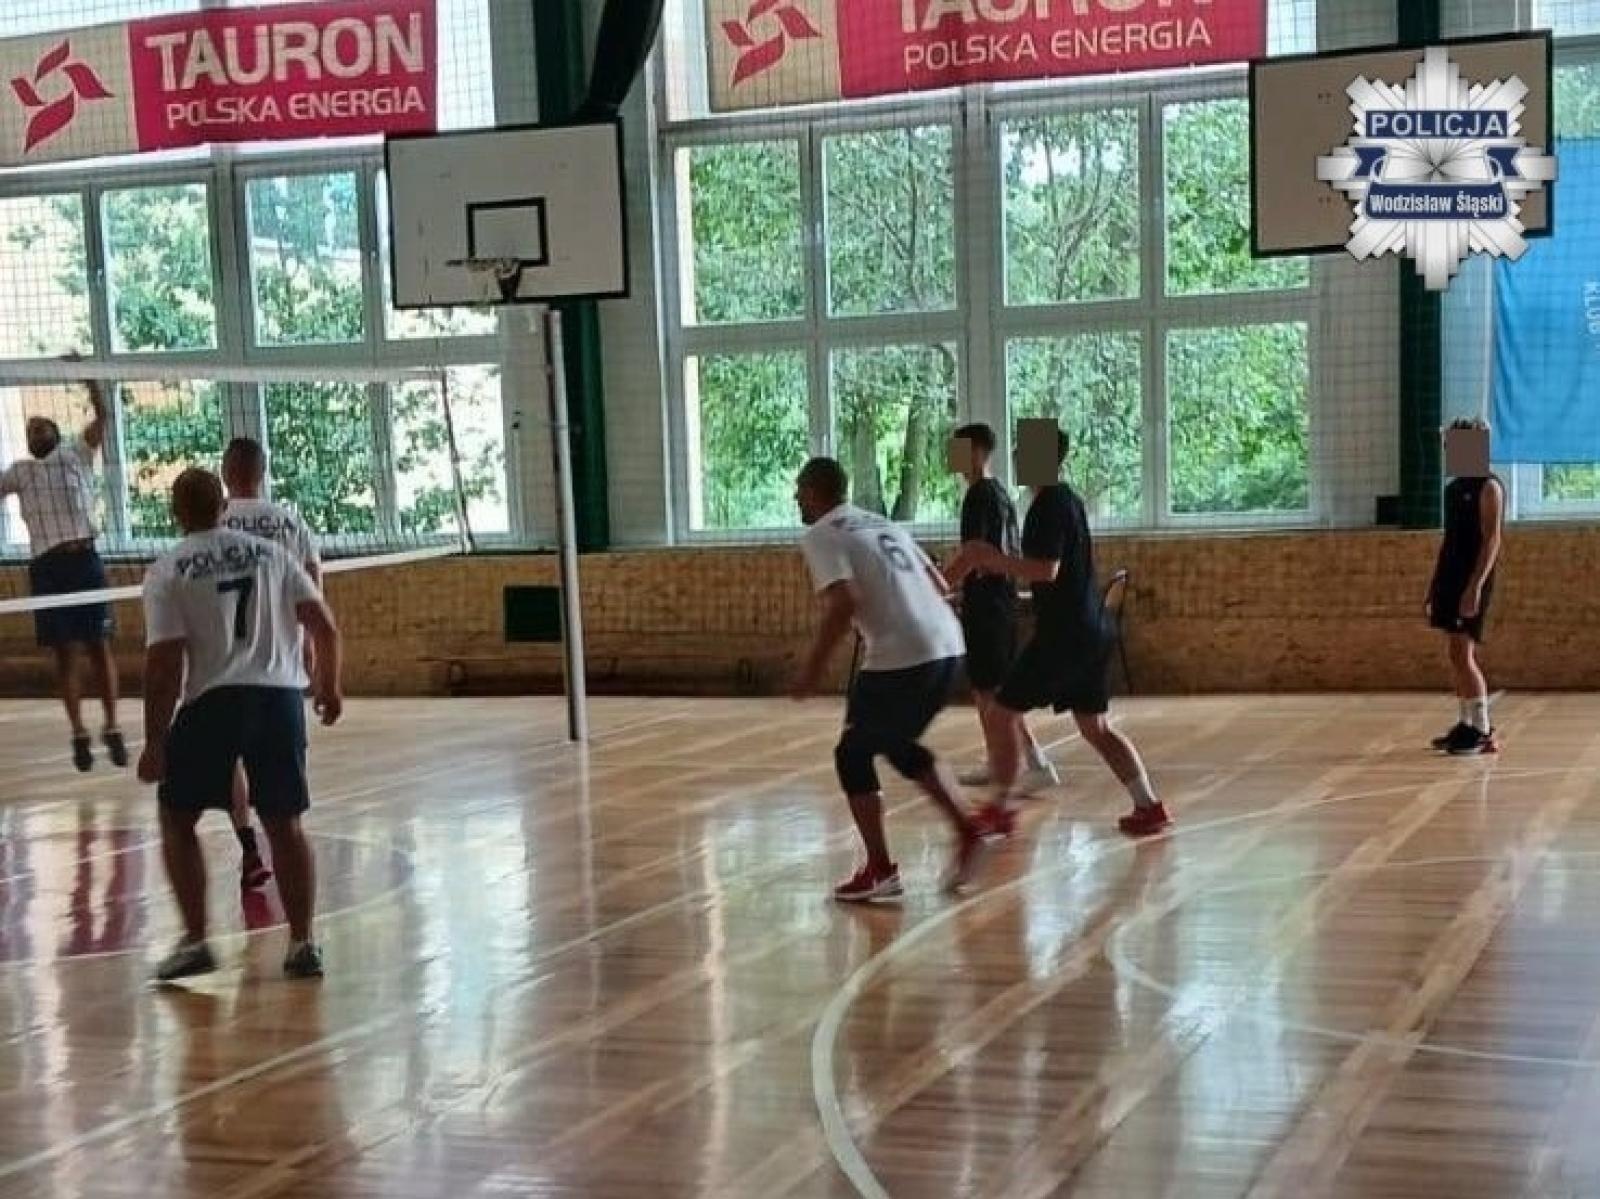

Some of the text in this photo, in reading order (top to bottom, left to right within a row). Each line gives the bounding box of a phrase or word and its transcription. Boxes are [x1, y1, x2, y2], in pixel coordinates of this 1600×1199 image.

[145, 12, 424, 92] TAURON
[903, 33, 1038, 73] POLSKA
[1050, 16, 1212, 60] ENERGIA
[166, 86, 425, 130] POLSKA ENERGIA
[222, 515, 294, 531] OLICJA
[877, 532, 913, 573] 6
[216, 576, 256, 639] 7
